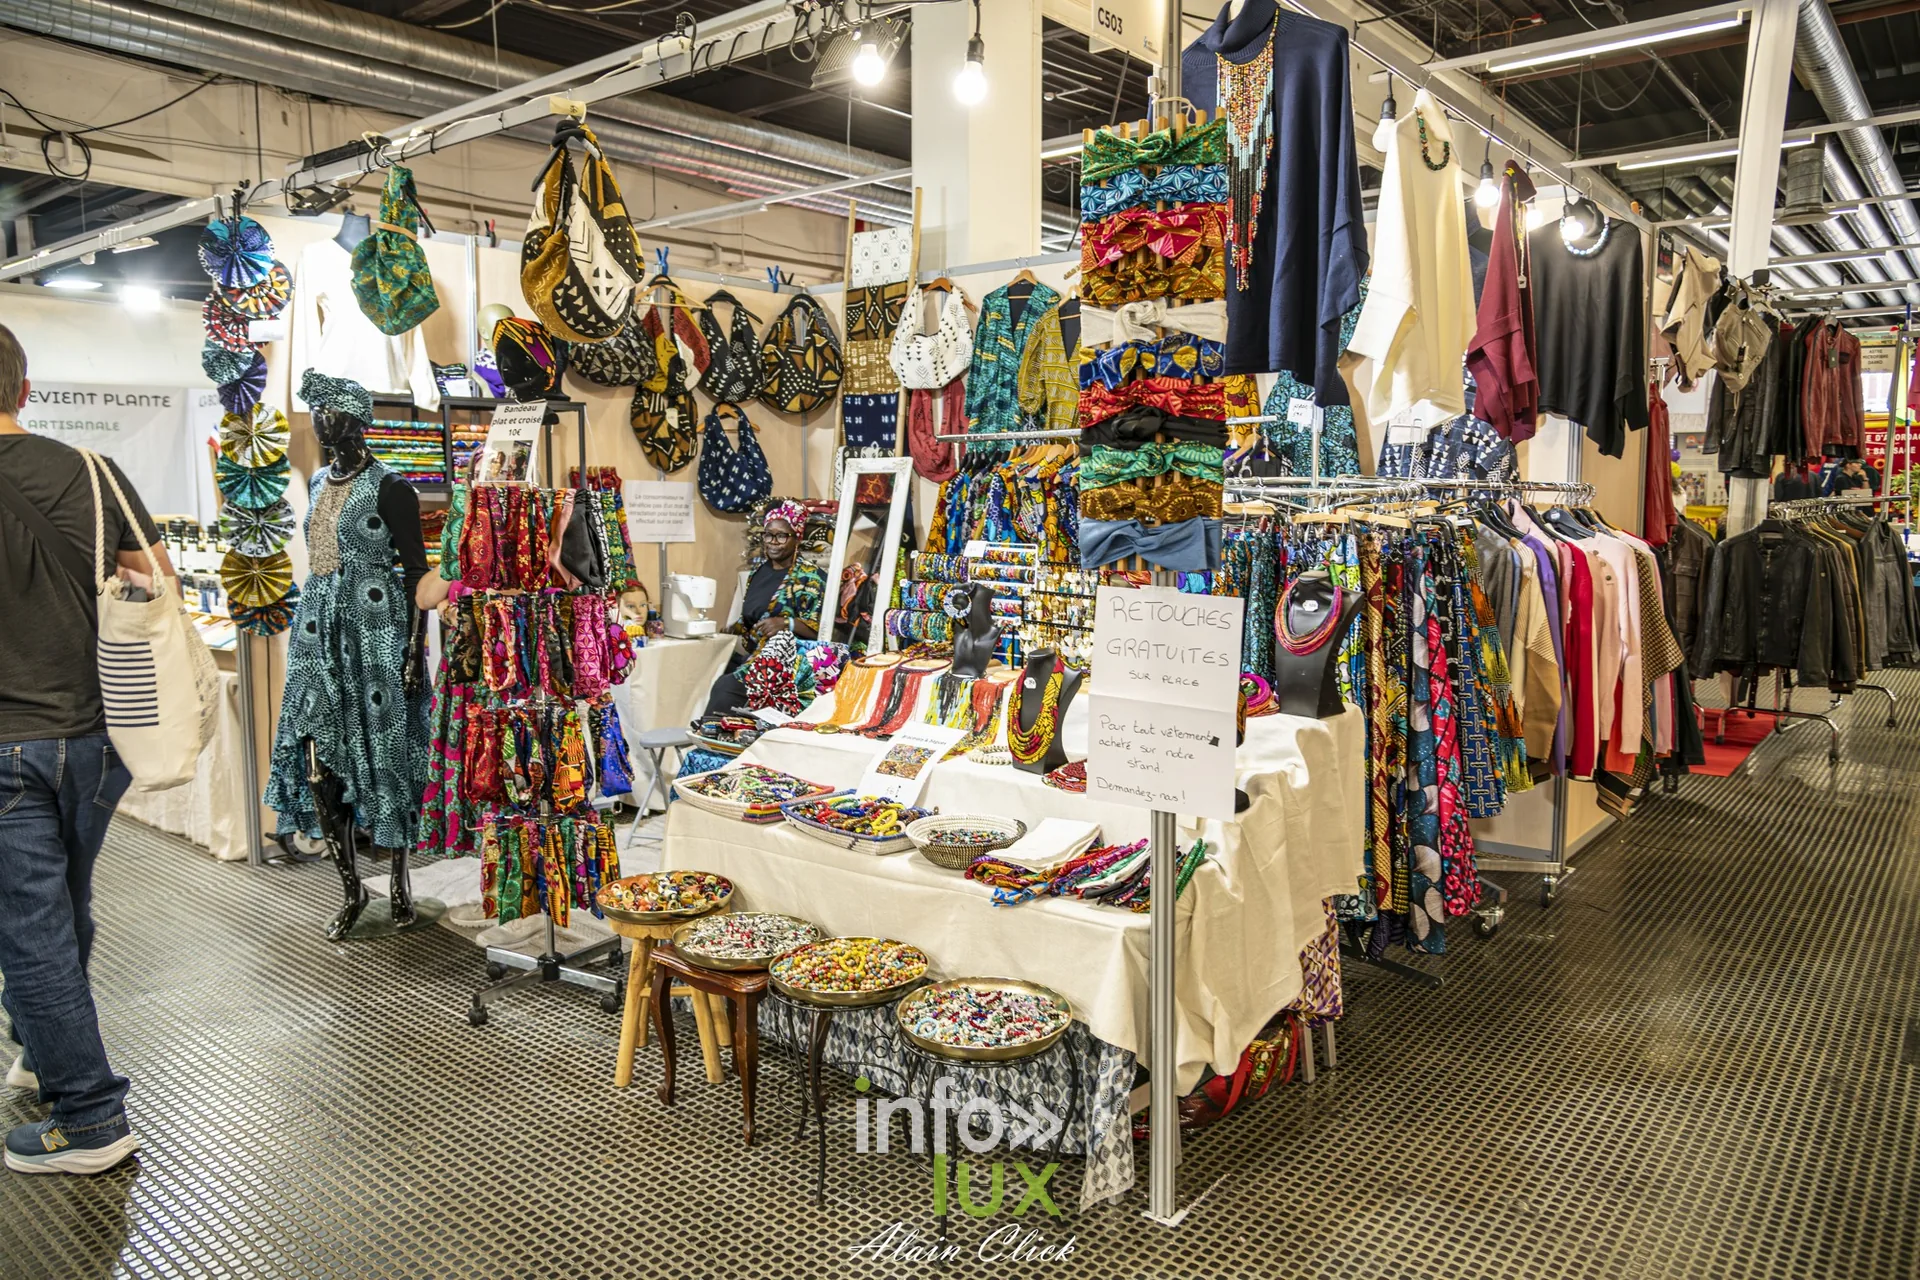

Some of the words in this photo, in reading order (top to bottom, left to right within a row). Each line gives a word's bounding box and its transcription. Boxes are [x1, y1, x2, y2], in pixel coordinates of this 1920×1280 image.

[1097, 7, 1123, 35] C503
[28, 390, 98, 406] EVIENT
[104, 392, 172, 408] PLANTE
[504, 405, 538, 413] Bandeau
[28, 419, 120, 432] ARTISANALE
[492, 418, 507, 427] plat
[508, 417, 517, 425] et
[518, 416, 542, 424] croisé
[1821, 470, 1832, 488] 7
[1110, 595, 1233, 630] RETOUCHES
[1128, 670, 1151, 681] SUR
[1162, 674, 1200, 687] PLACE
[1099, 714, 1126, 732] Pour
[1133, 720, 1156, 735] tout
[1098, 736, 1132, 751] acheté
[1140, 744, 1157, 755] sur
[1165, 748, 1196, 760] notre
[1127, 757, 1164, 774] stand.
[40, 1128, 69, 1152] N
